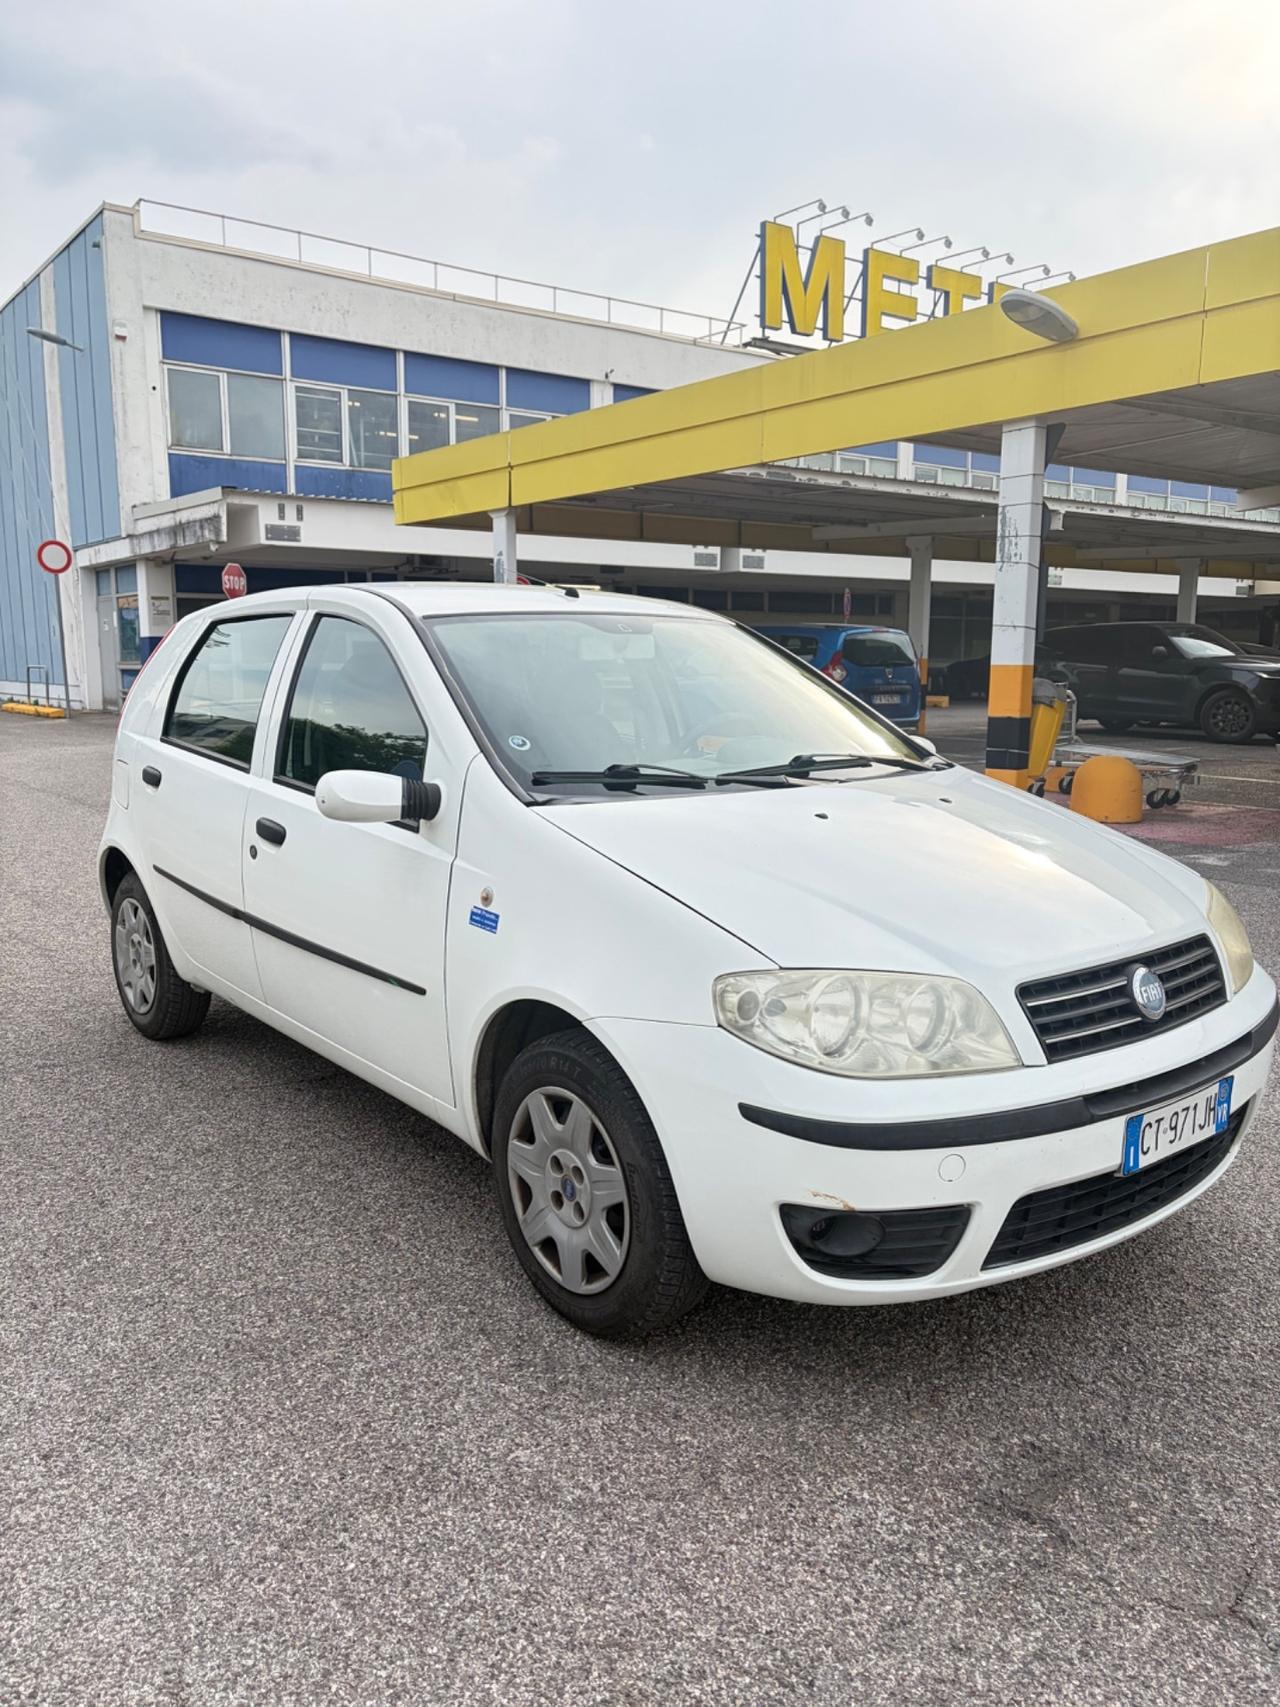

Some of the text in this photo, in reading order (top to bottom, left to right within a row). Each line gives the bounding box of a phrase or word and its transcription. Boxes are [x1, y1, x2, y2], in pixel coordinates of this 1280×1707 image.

[760, 220, 1014, 342] MET
[224, 574, 245, 590] STOP
[1141, 982, 1162, 1004] FIAT
